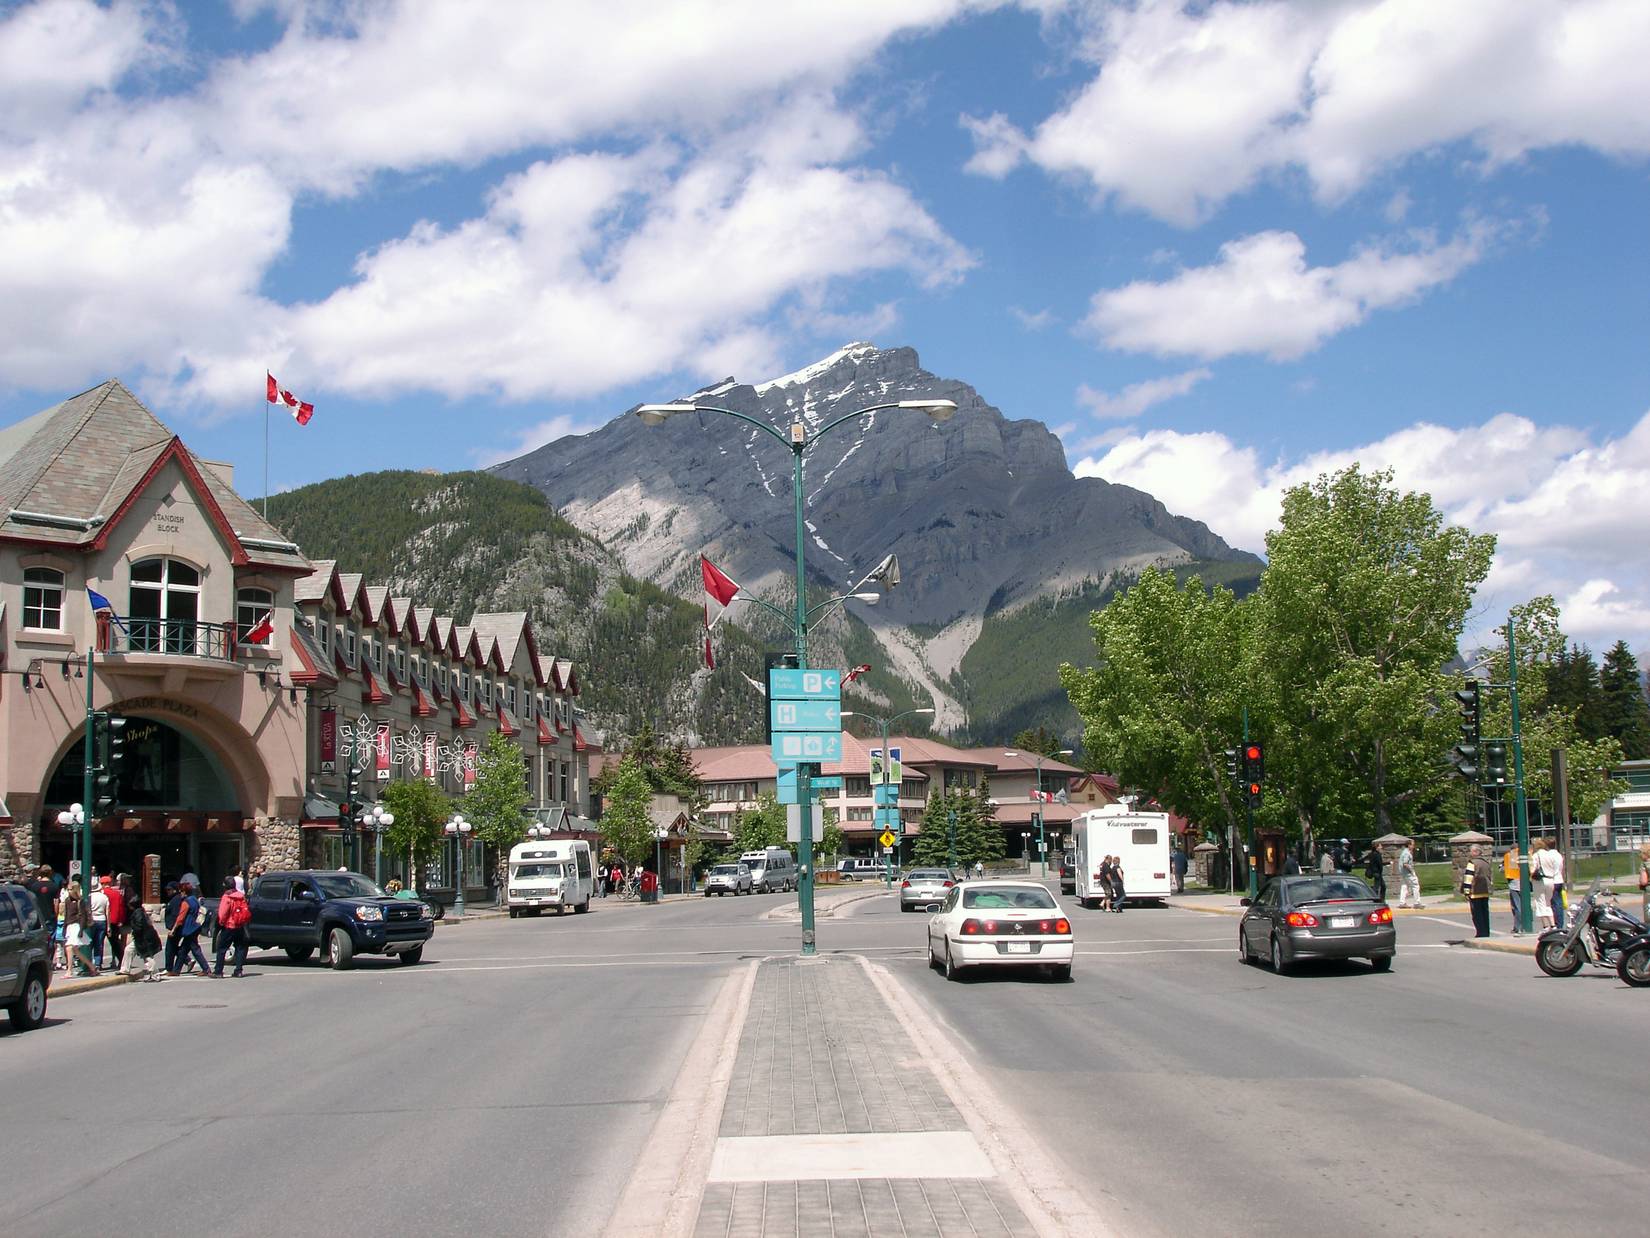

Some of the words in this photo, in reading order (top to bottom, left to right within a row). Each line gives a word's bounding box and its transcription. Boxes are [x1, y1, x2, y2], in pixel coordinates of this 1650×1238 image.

[153, 513, 184, 524] STANDISH
[157, 524, 179, 533] BLOCK
[163, 698, 198, 719] PLAZA
[124, 724, 159, 743] Shops
